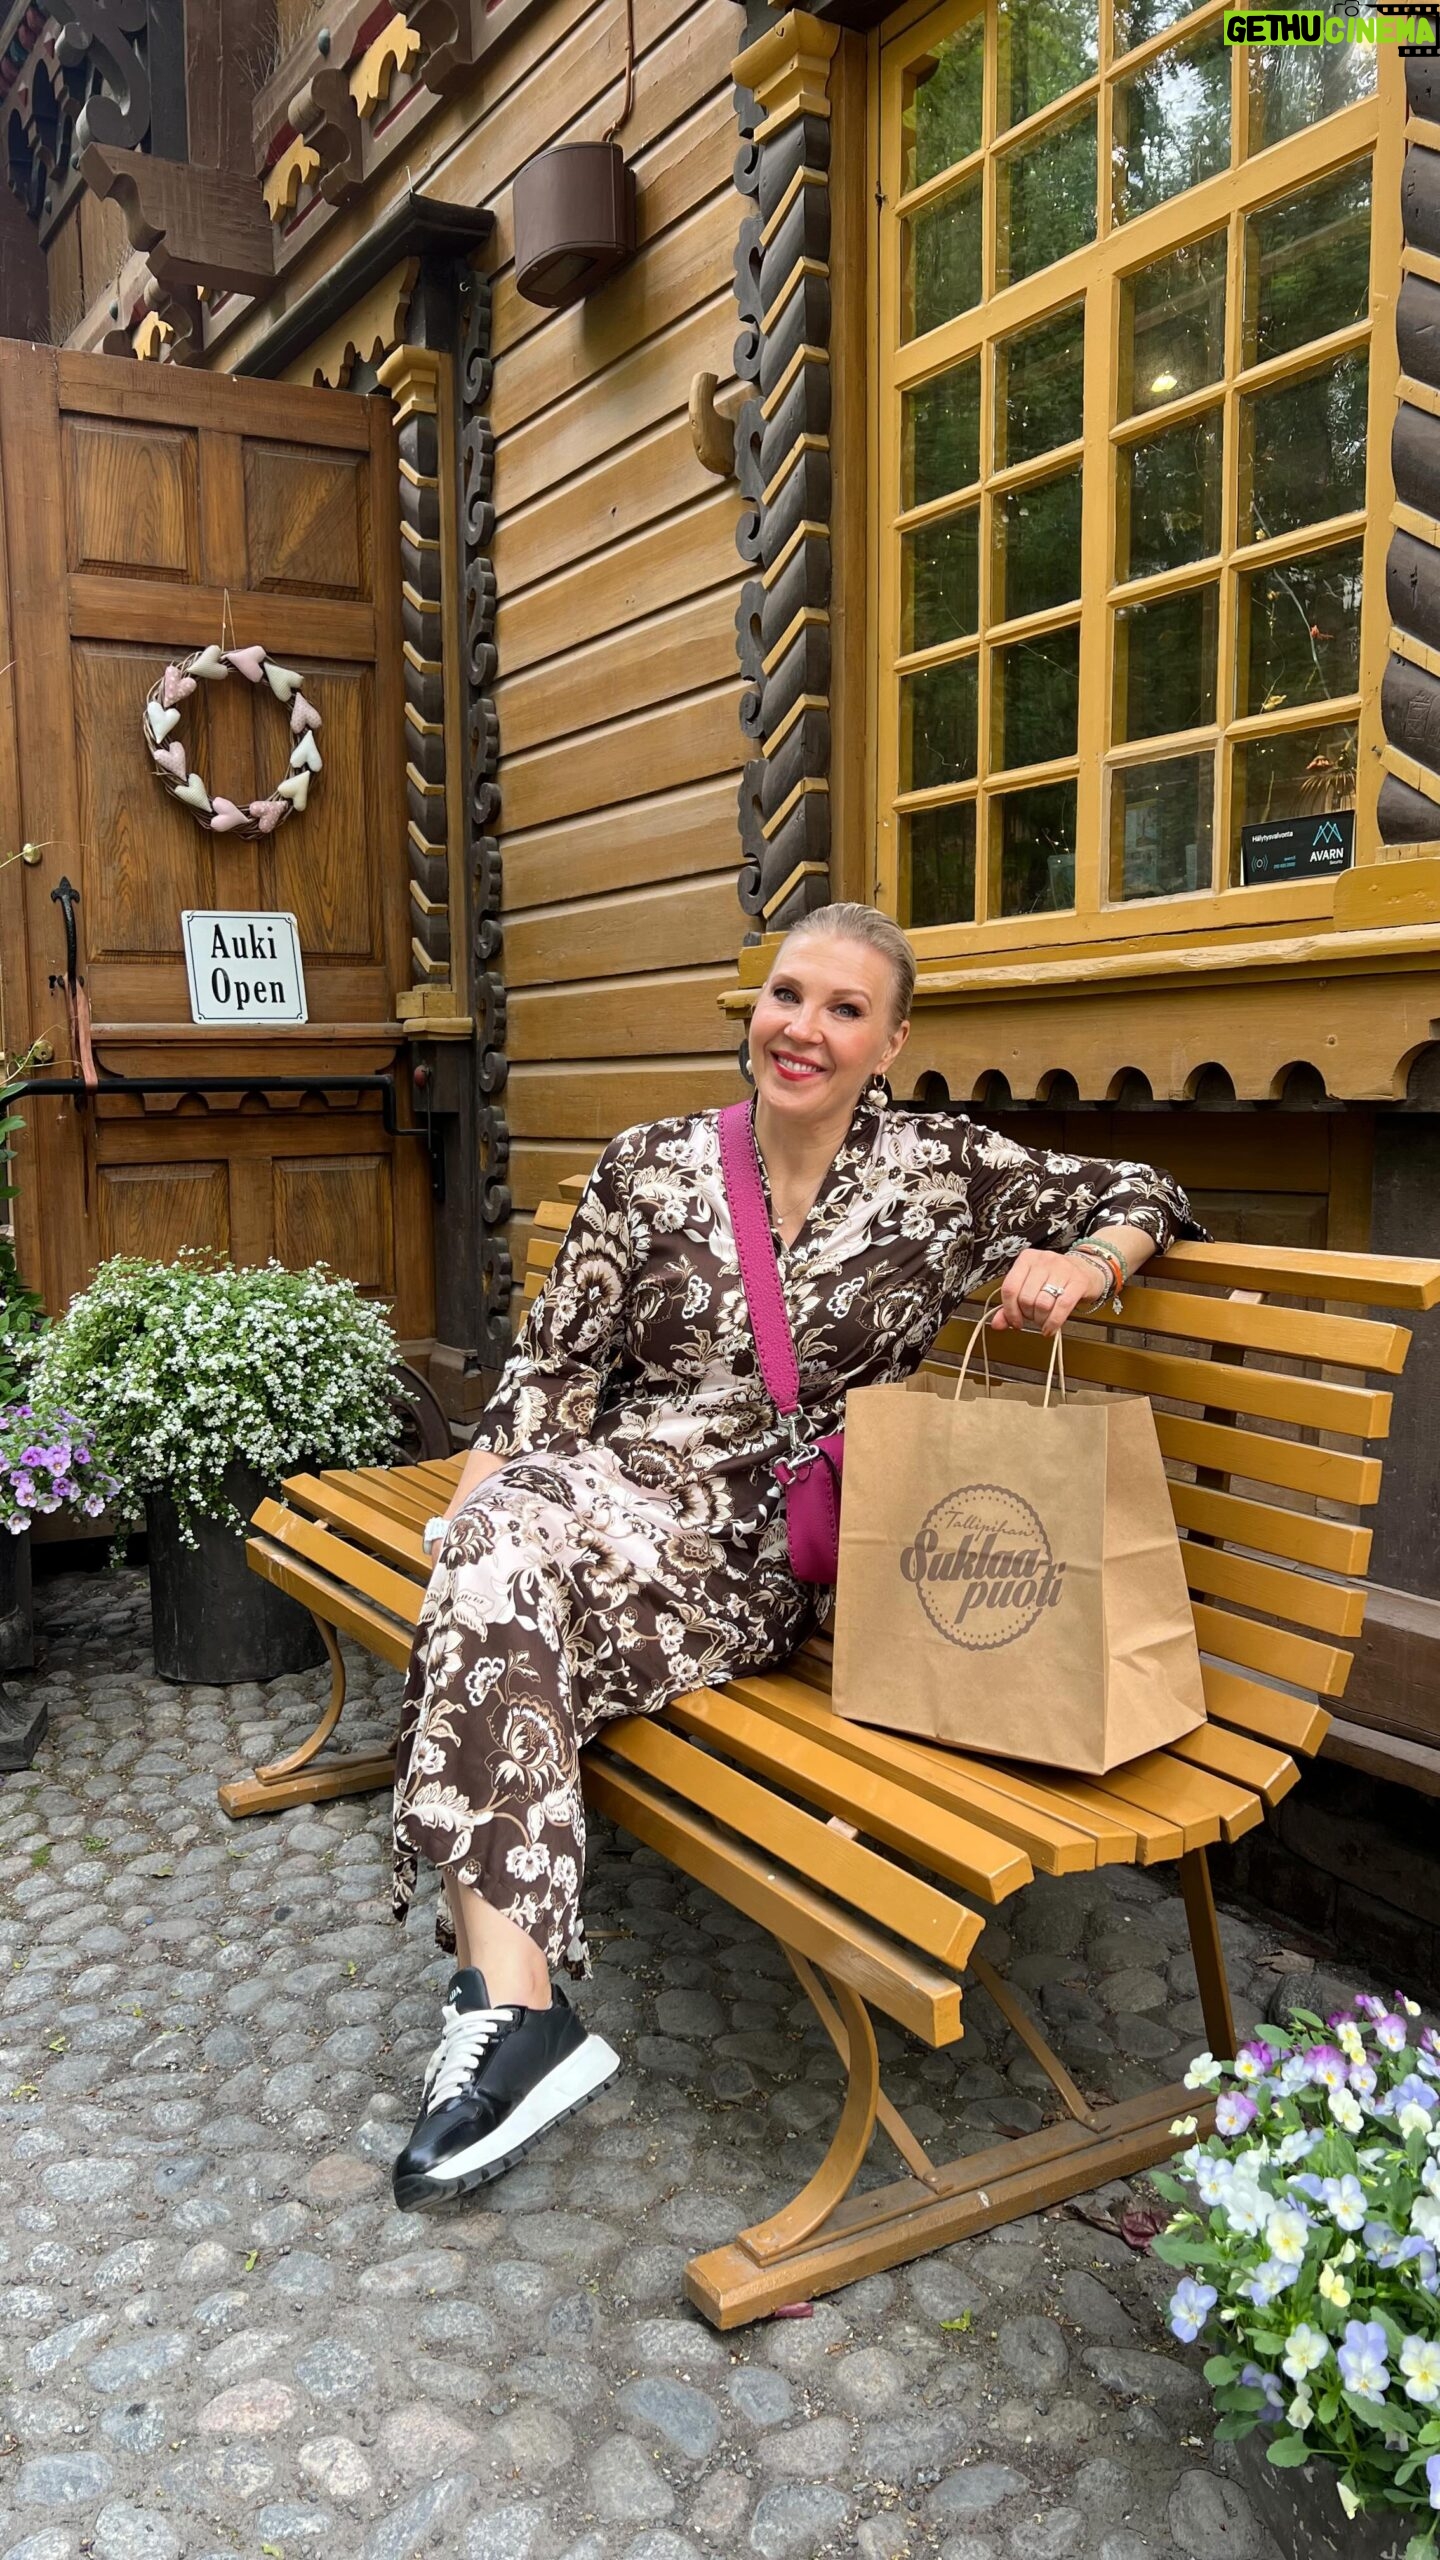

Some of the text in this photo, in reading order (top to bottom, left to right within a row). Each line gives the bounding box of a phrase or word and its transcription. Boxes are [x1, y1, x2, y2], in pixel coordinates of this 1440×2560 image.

[1309, 847, 1344, 862] AVARN
[211, 923, 278, 959] Auki
[211, 967, 286, 1010] Open
[946, 1510, 1035, 1542] Tallipihan
[954, 1561, 1067, 1624] puoti
